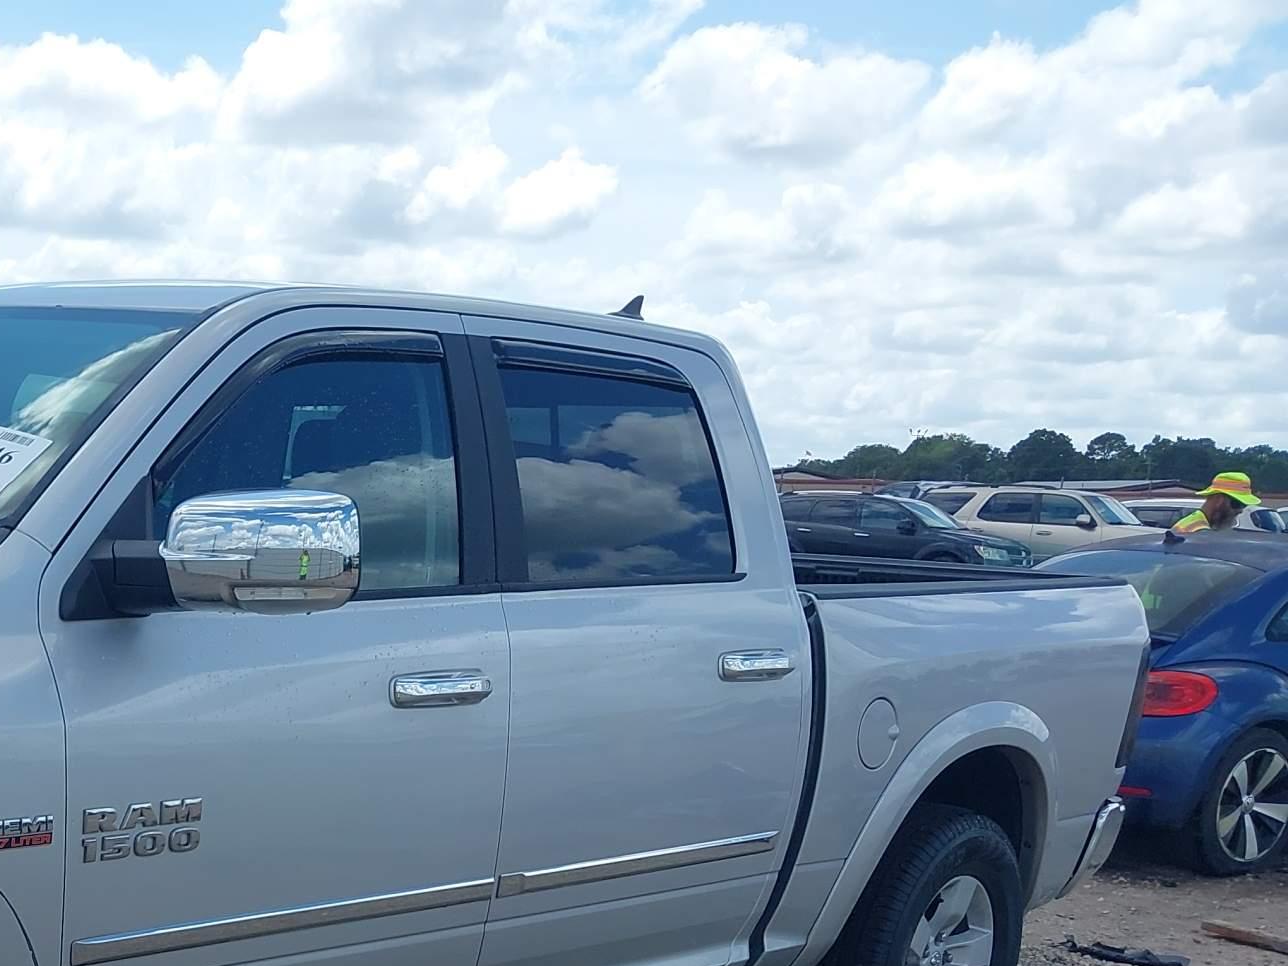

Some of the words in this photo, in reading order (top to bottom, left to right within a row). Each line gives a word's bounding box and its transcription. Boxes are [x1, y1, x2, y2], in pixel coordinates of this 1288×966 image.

[83, 798, 203, 834] RAM
[11, 833, 52, 848] LITER
[82, 827, 201, 863] 1500
